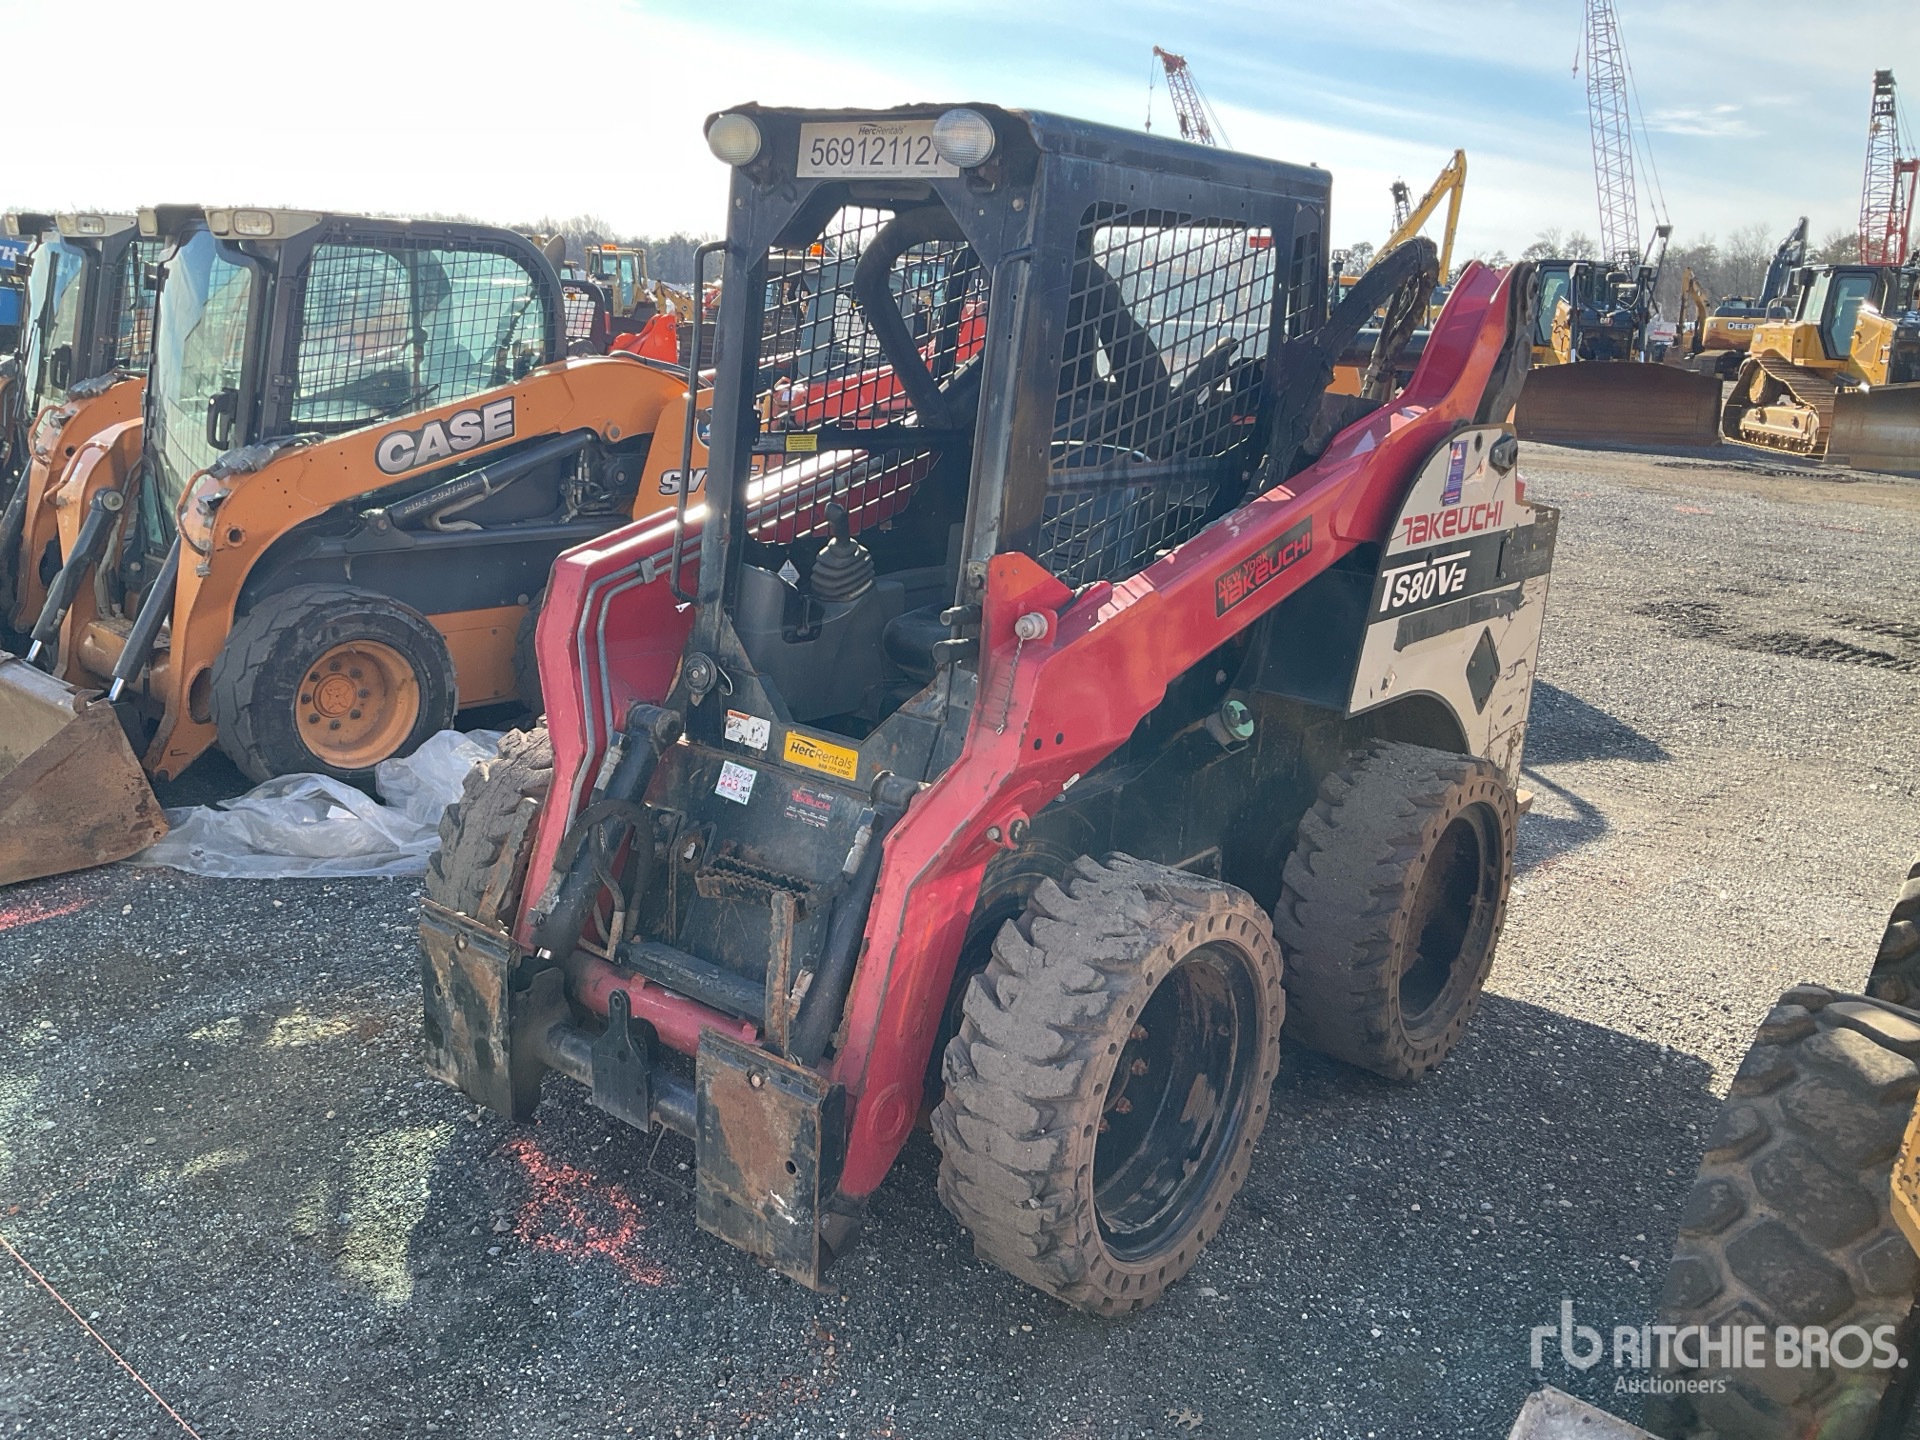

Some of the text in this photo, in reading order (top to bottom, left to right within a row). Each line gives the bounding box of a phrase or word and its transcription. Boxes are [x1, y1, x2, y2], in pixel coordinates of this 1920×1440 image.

[1728, 321, 1757, 330] DEER
[375, 397, 515, 474] CASE
[1218, 550, 1268, 592] NEW YORK
